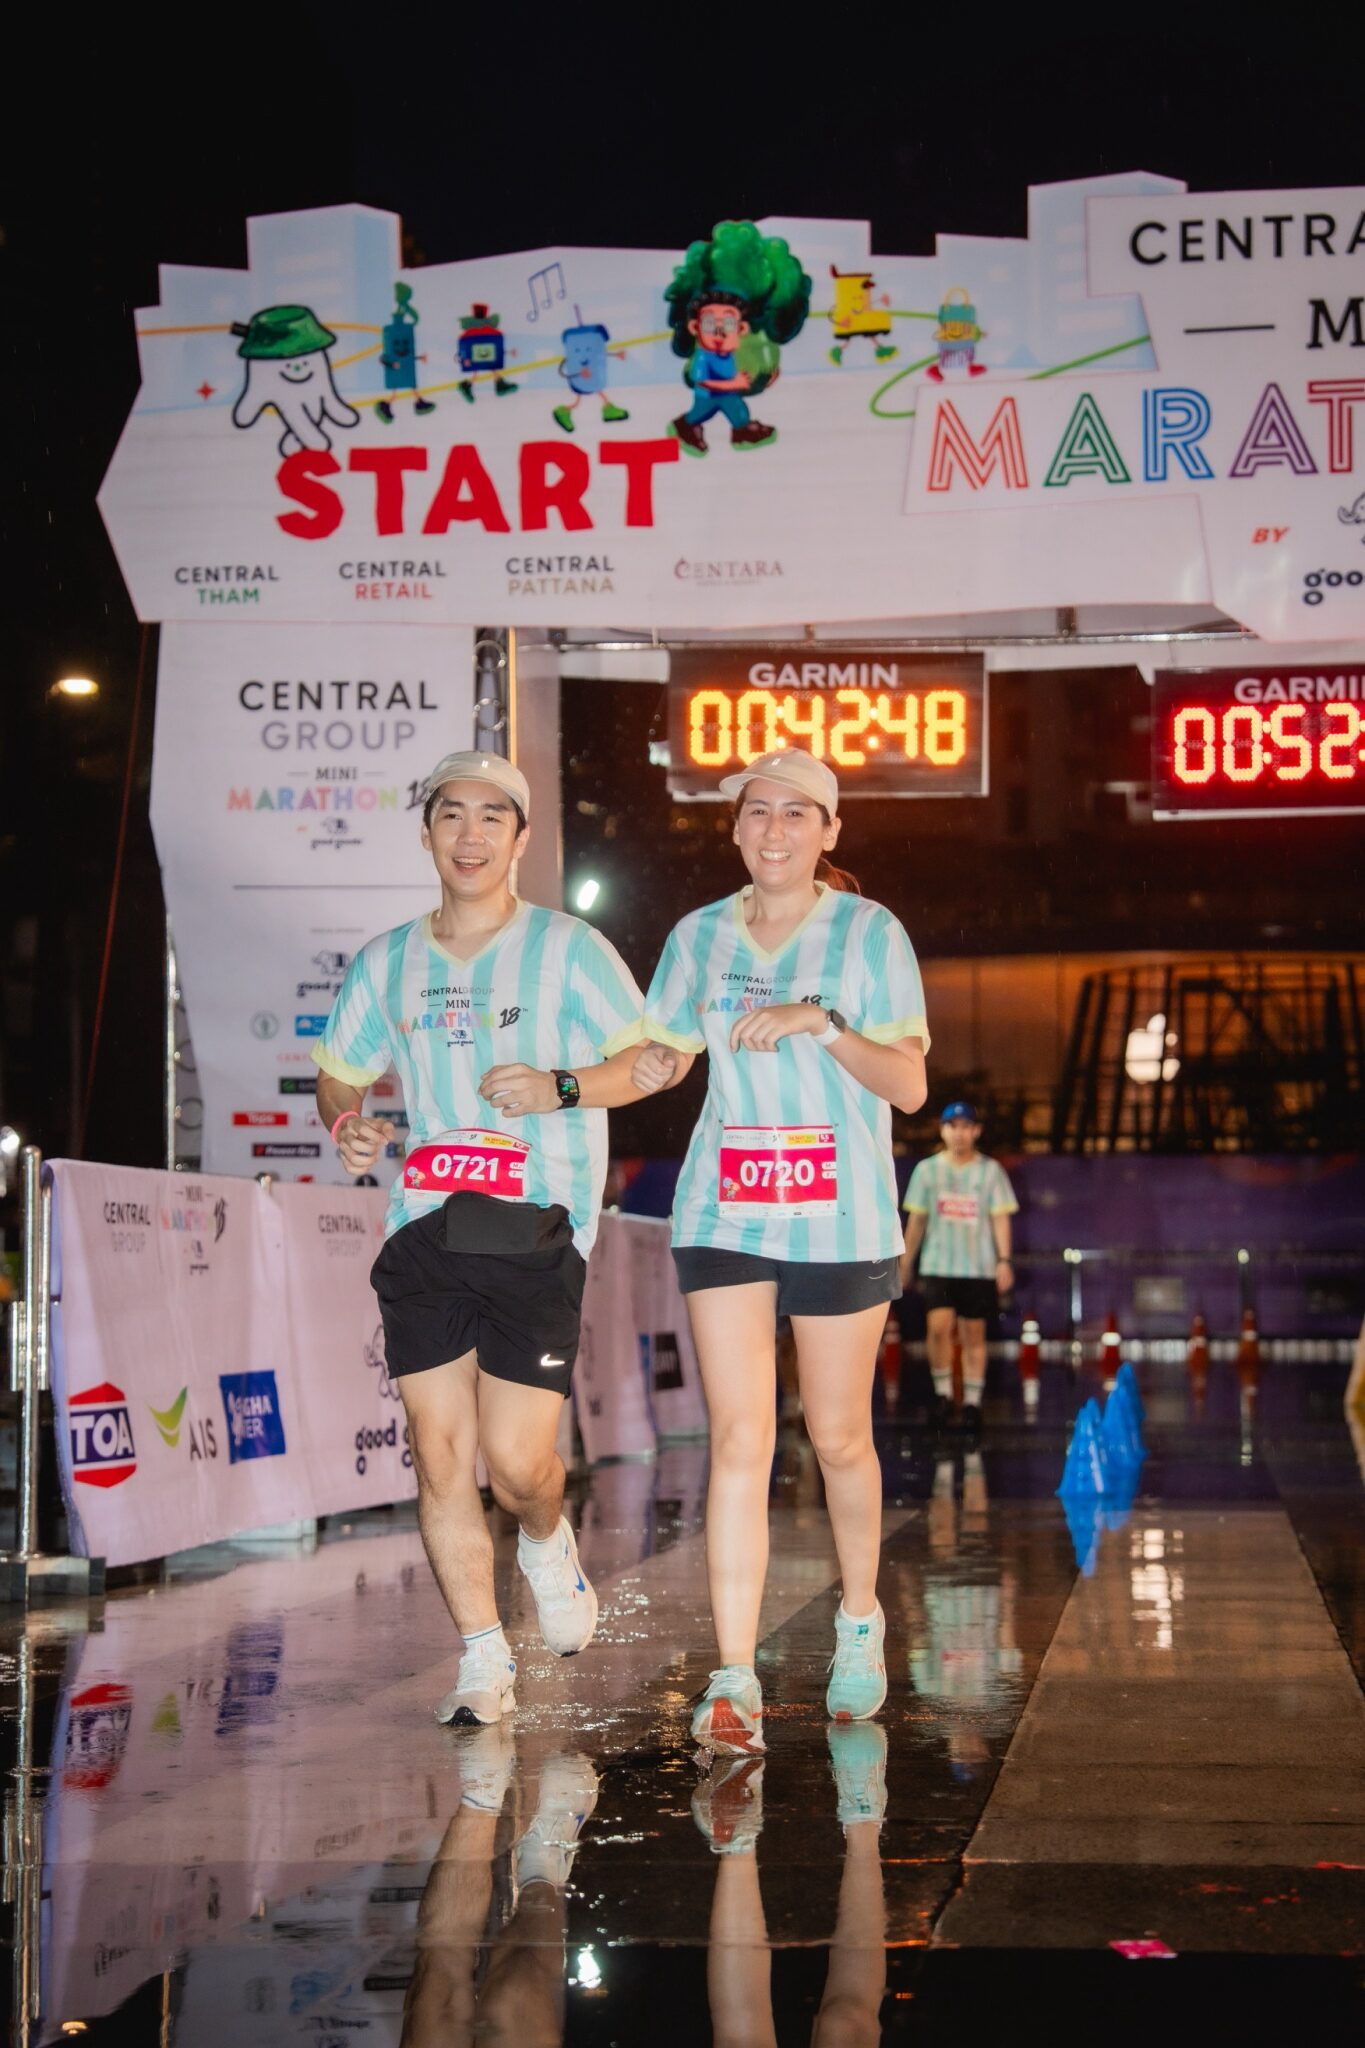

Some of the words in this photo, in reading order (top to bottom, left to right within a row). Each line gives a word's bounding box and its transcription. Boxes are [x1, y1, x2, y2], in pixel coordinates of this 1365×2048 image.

[276, 437, 680, 541] START
[1252, 526, 1290, 544] BY
[175, 565, 279, 585] CENTRAL
[339, 561, 447, 580] CENTRAL
[505, 556, 614, 576] CENTRAL
[673, 557, 784, 580] CENTARA
[197, 587, 260, 605] THAM
[355, 582, 432, 600] RETAIL
[508, 577, 614, 596] PATTANA
[748, 662, 899, 689] GARMIN
[238, 680, 438, 711] CENTRAL
[1234, 675, 1365, 704] GARMI
[261, 721, 416, 752] GROUP
[689, 688, 966, 767] 00:42:48
[315, 766, 358, 781] MINI
[227, 786, 398, 812] MARATHON
[744, 986, 773, 997] MINI
[445, 1000, 471, 1009] MINI
[498, 1006, 522, 1029] 18
[431, 1153, 500, 1182] 0721
[740, 1159, 816, 1187] 0720
[103, 1201, 151, 1226] CENTRAL
[318, 1214, 366, 1234] CENTRAL
[71, 1411, 134, 1462] TOA
[189, 1417, 217, 1461] AIS
[355, 1418, 397, 1476] good
